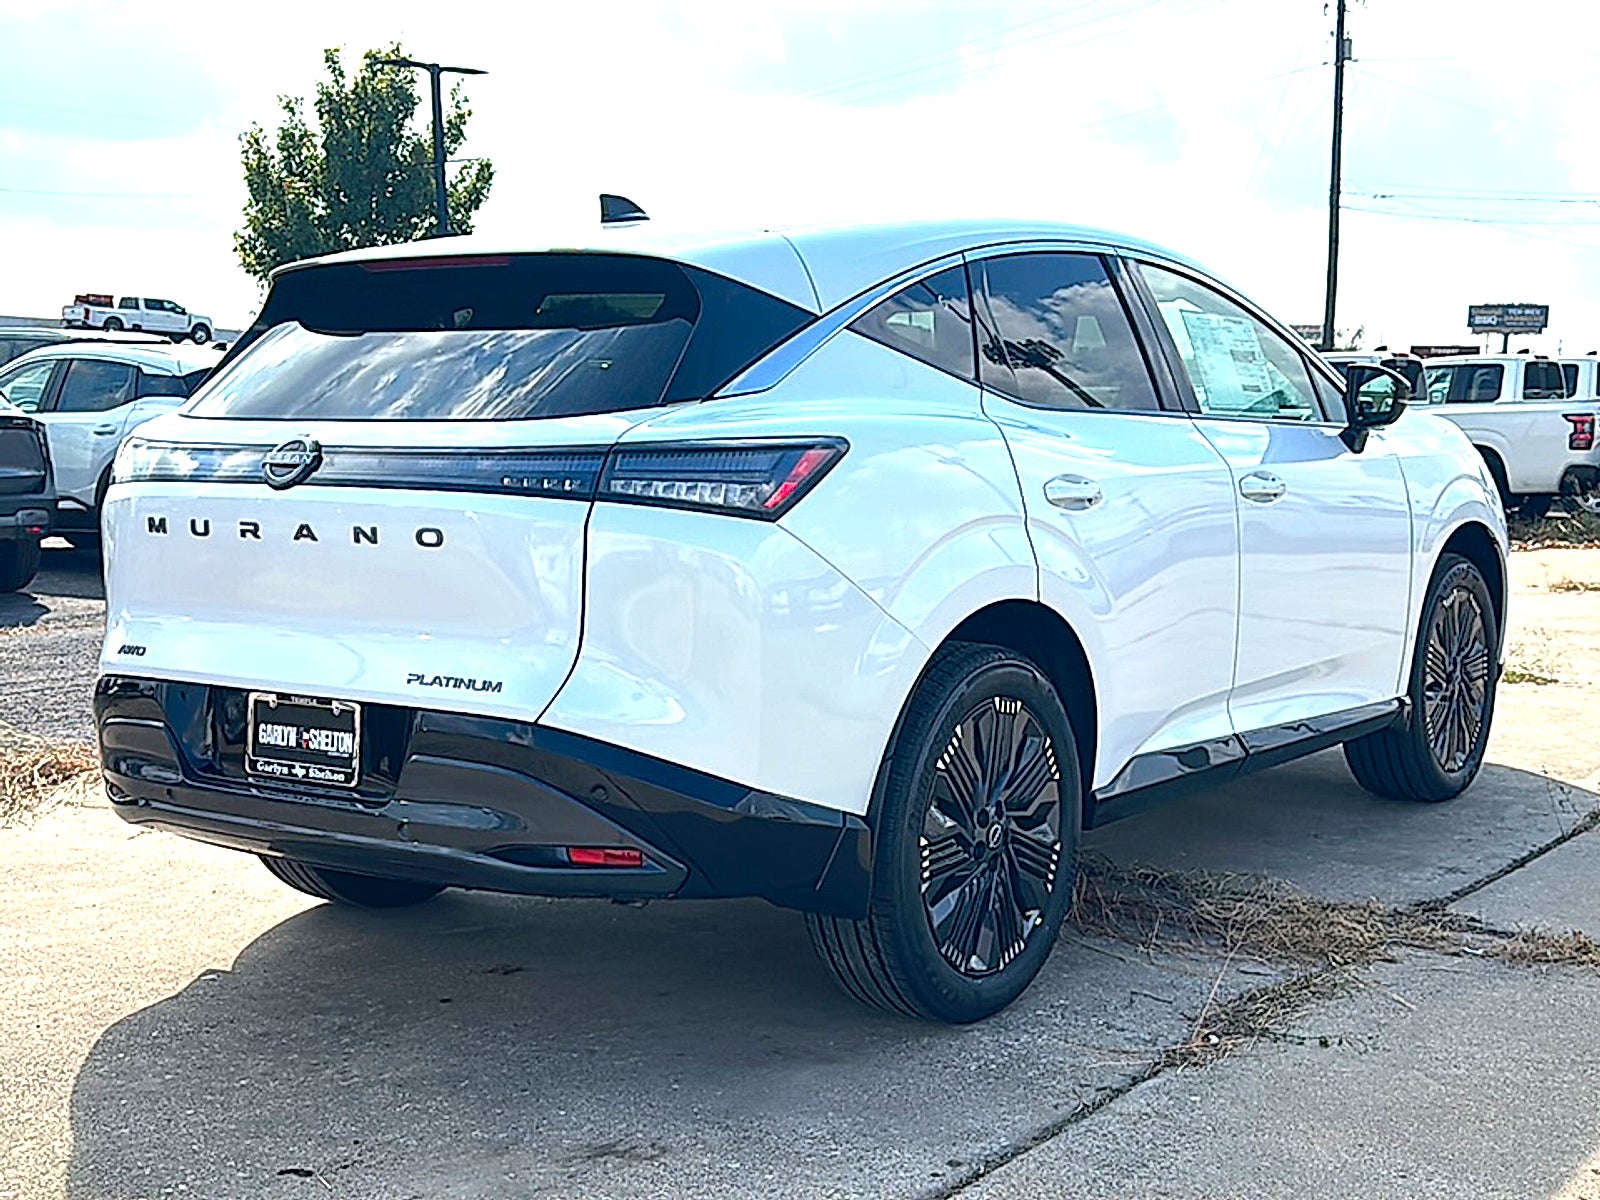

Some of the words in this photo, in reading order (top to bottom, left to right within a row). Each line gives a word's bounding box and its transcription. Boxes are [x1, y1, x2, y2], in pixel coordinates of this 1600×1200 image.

[147, 516, 444, 548] MURANO
[406, 673, 503, 693] PLATINUM
[308, 728, 354, 754] SHELTON
